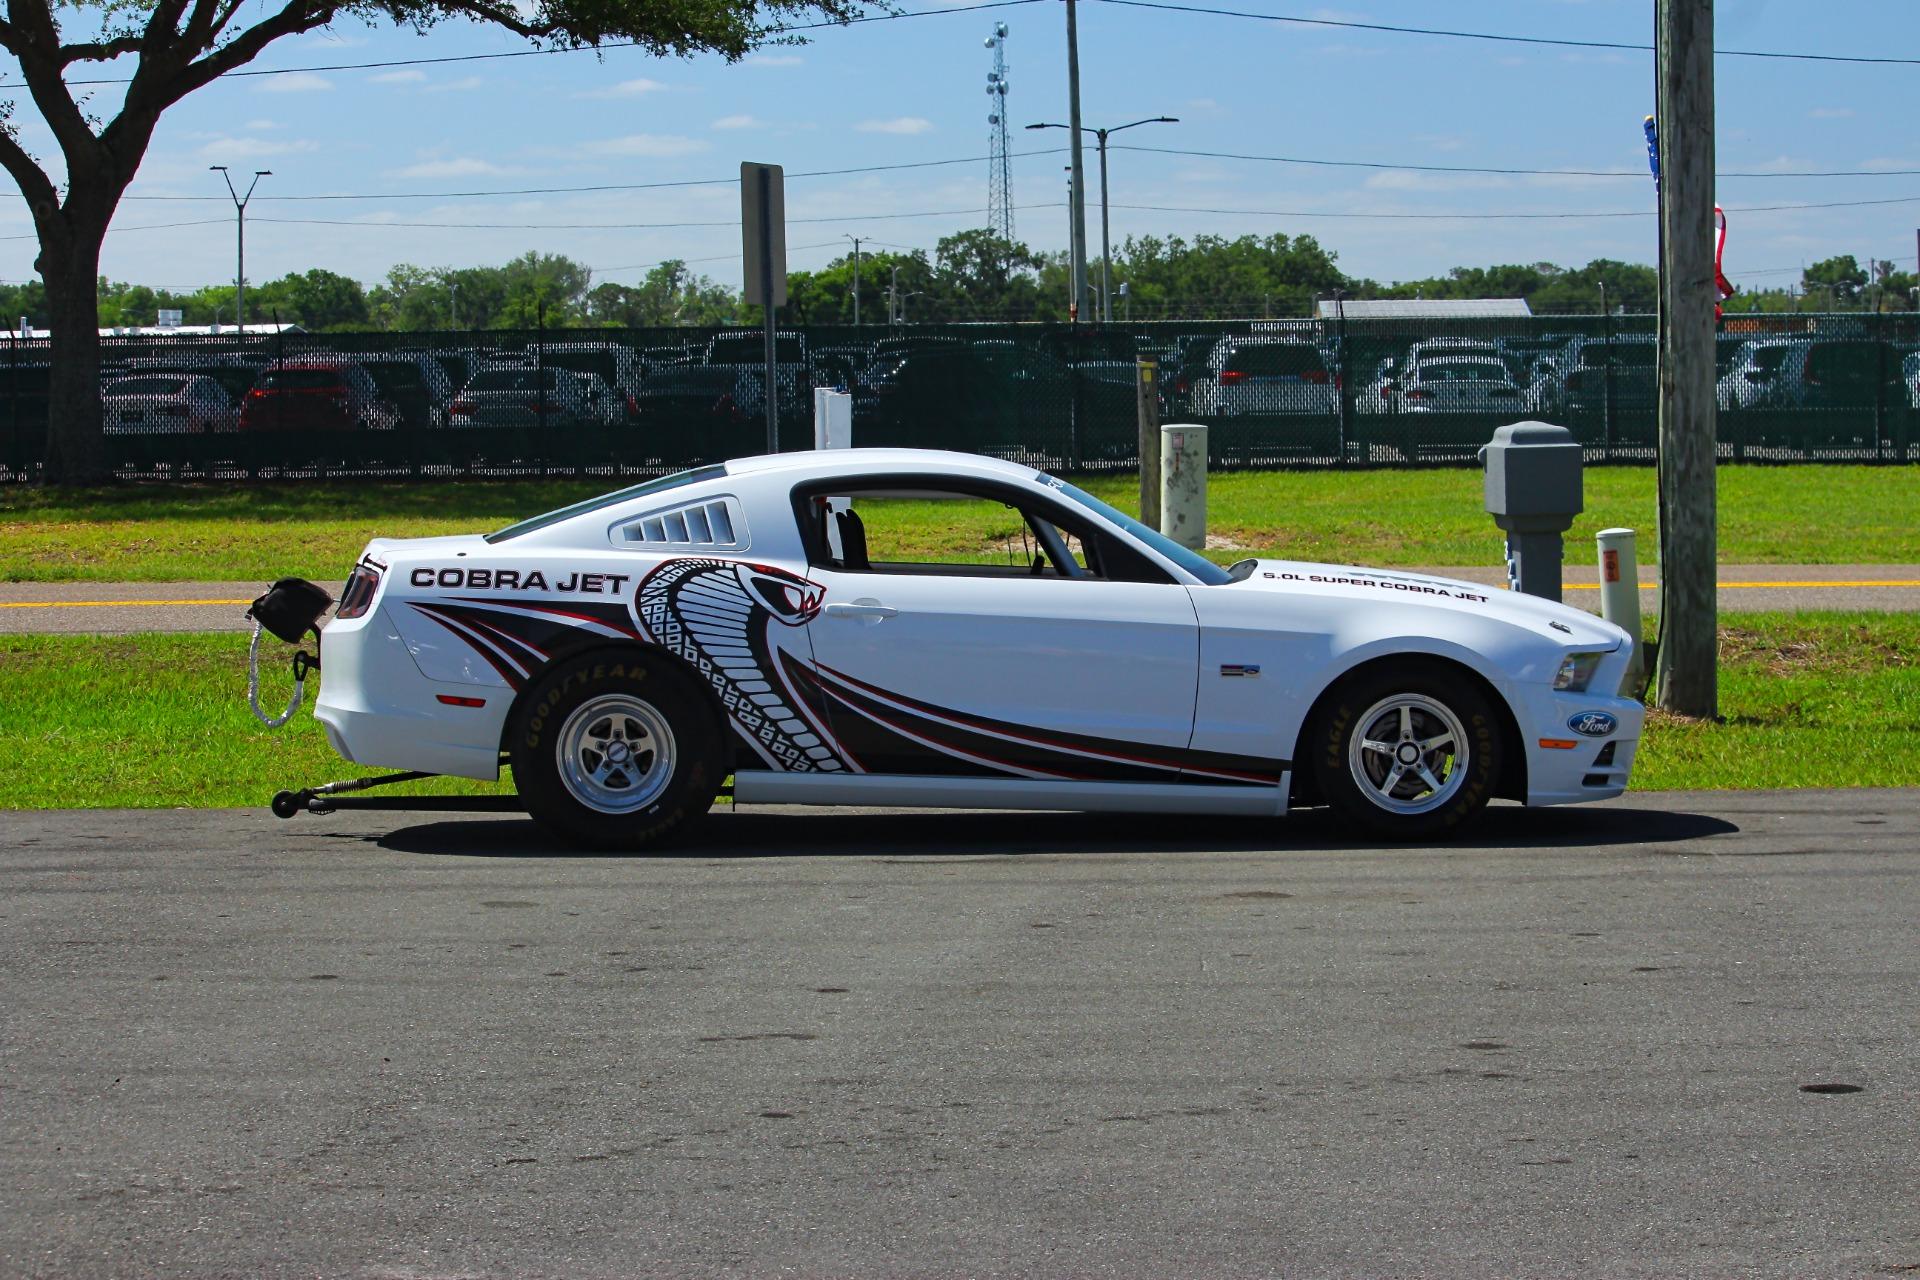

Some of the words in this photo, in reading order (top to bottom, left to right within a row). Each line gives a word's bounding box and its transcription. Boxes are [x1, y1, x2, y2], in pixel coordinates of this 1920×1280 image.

[410, 568, 549, 591] COBRA
[556, 572, 630, 594] JET
[1263, 572, 1305, 581] 5.0L
[1309, 575, 1375, 587] SUPER
[1380, 582, 1449, 596] COBRA
[1455, 592, 1488, 603] JET
[1578, 714, 1612, 732] Ford
